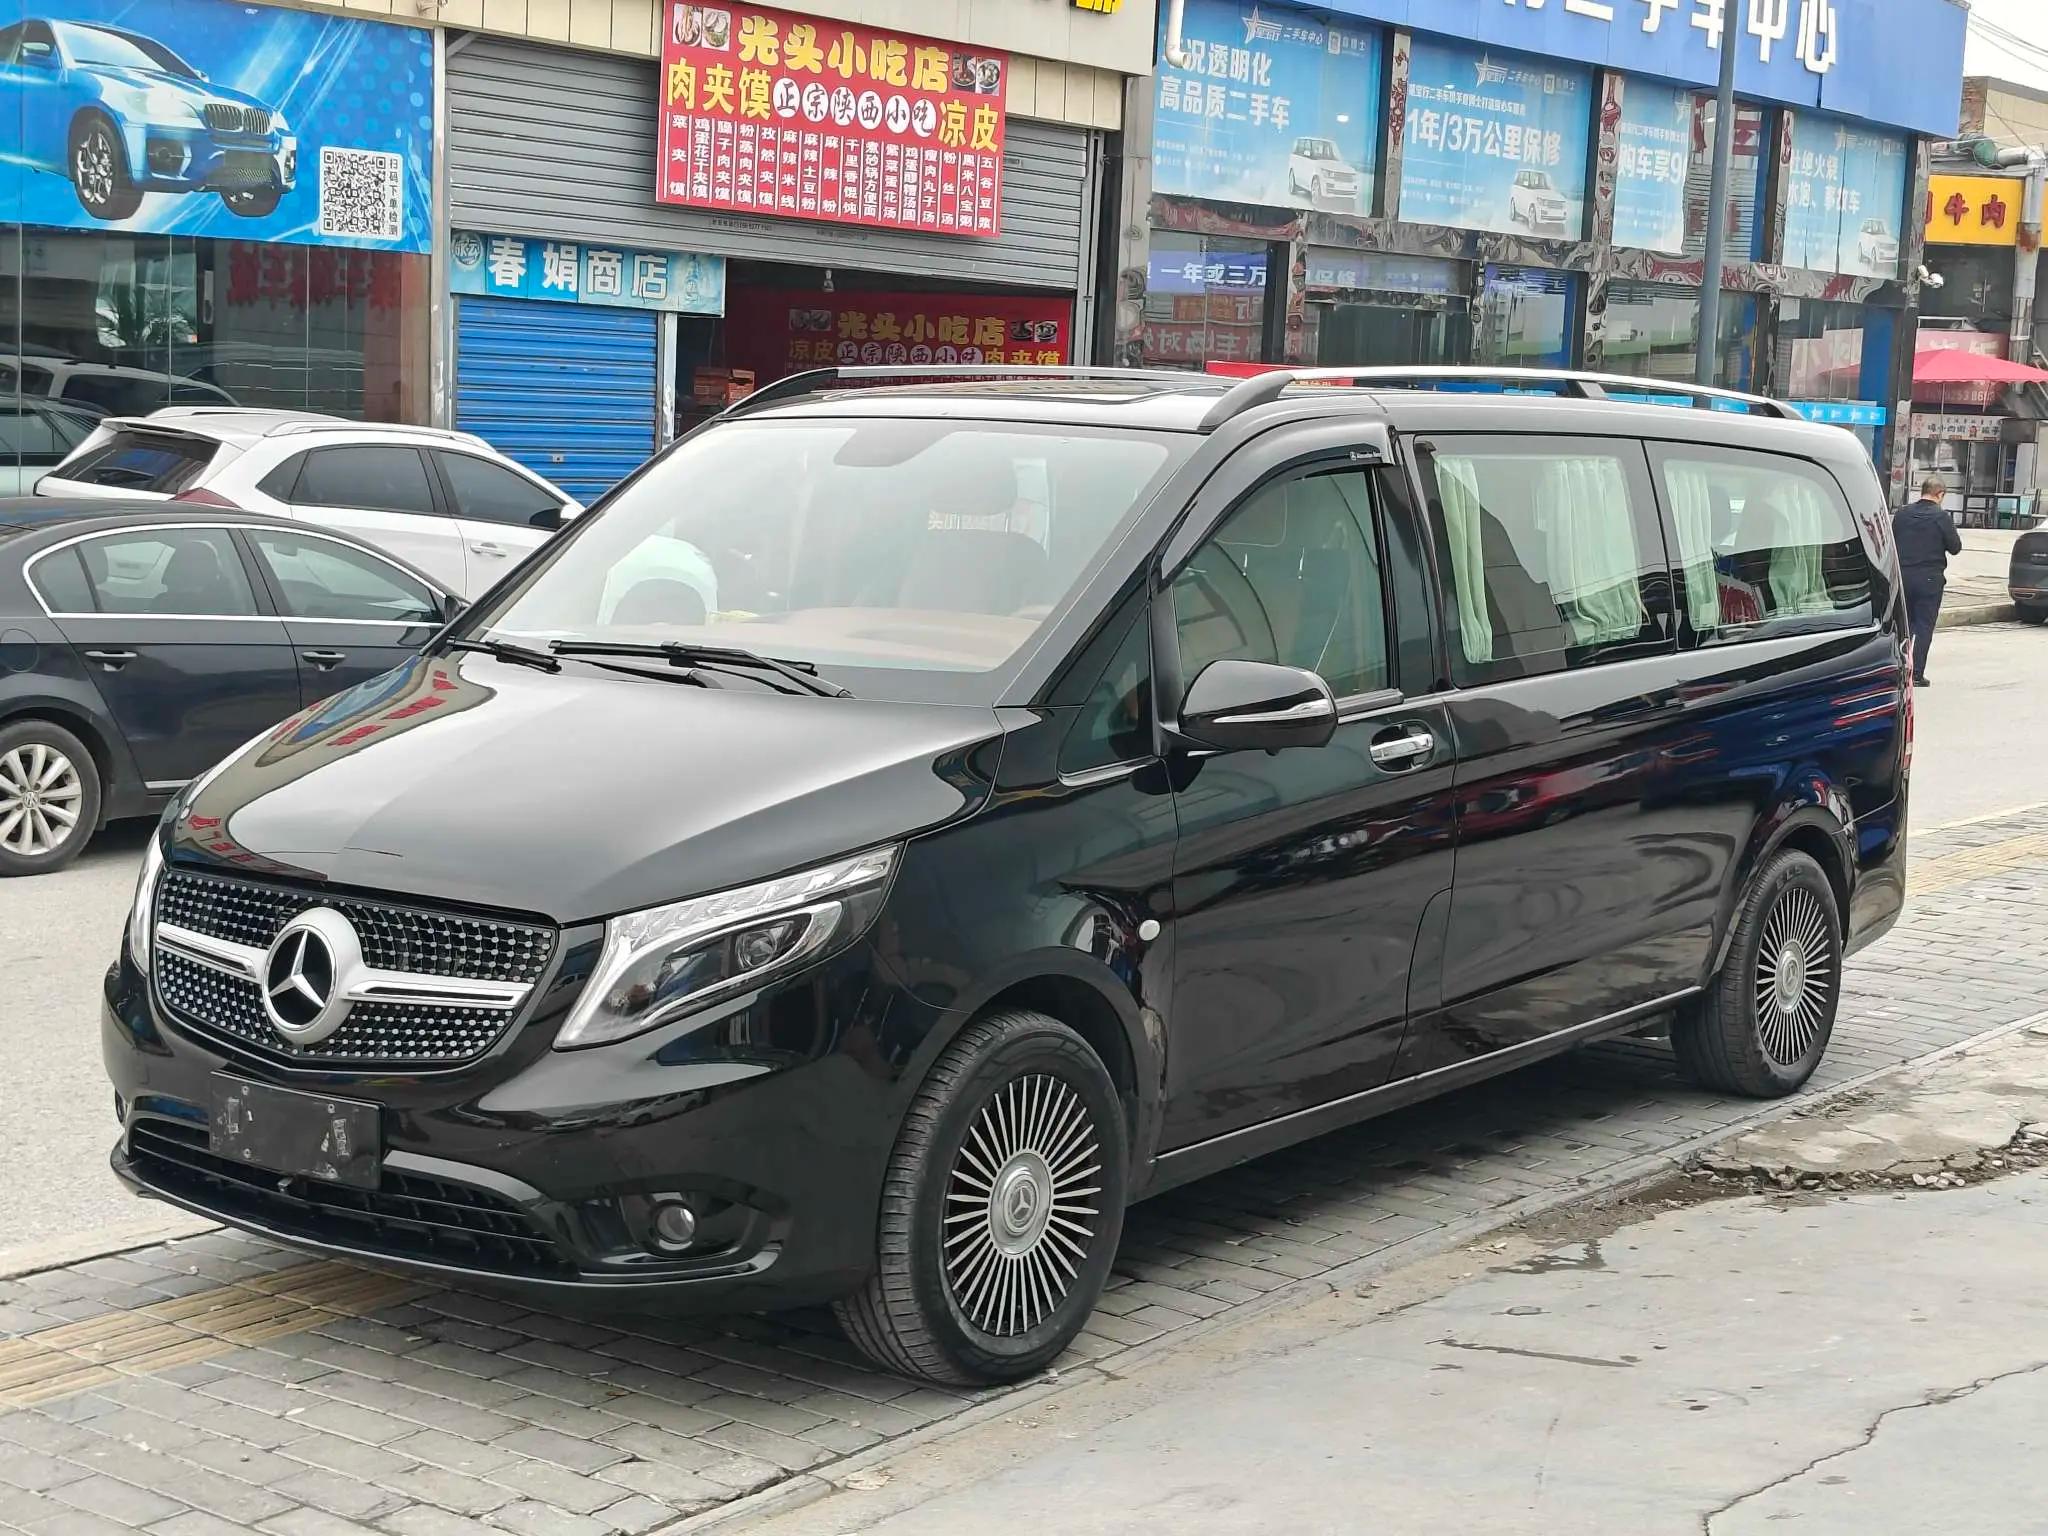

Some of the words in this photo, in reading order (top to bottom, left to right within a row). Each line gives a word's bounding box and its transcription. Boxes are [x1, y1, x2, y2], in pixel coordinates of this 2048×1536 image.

[737, 15, 949, 93] 光头小吃店
[1163, 38, 1272, 87] 况透明化
[667, 57, 771, 120] 肉夹馍
[773, 77, 937, 138] 正宗陕西小吃
[938, 100, 999, 152] 凉皮
[1159, 76, 1290, 131] 高品质二手车
[1407, 108, 1561, 166] 1年/3万公里保修
[670, 114, 689, 197] 菜夹馍
[780, 129, 798, 209] 麻辣米线
[801, 132, 819, 211] 麻辣土豆粉
[822, 135, 839, 213] 麻辣粉
[882, 143, 900, 220] 紫菜蛋花汤
[941, 151, 957, 226] 粉丝汤
[1924, 190, 2007, 230] 牛肉
[488, 237, 669, 299] 春娟商店
[837, 310, 1006, 347] 光头小吃店
